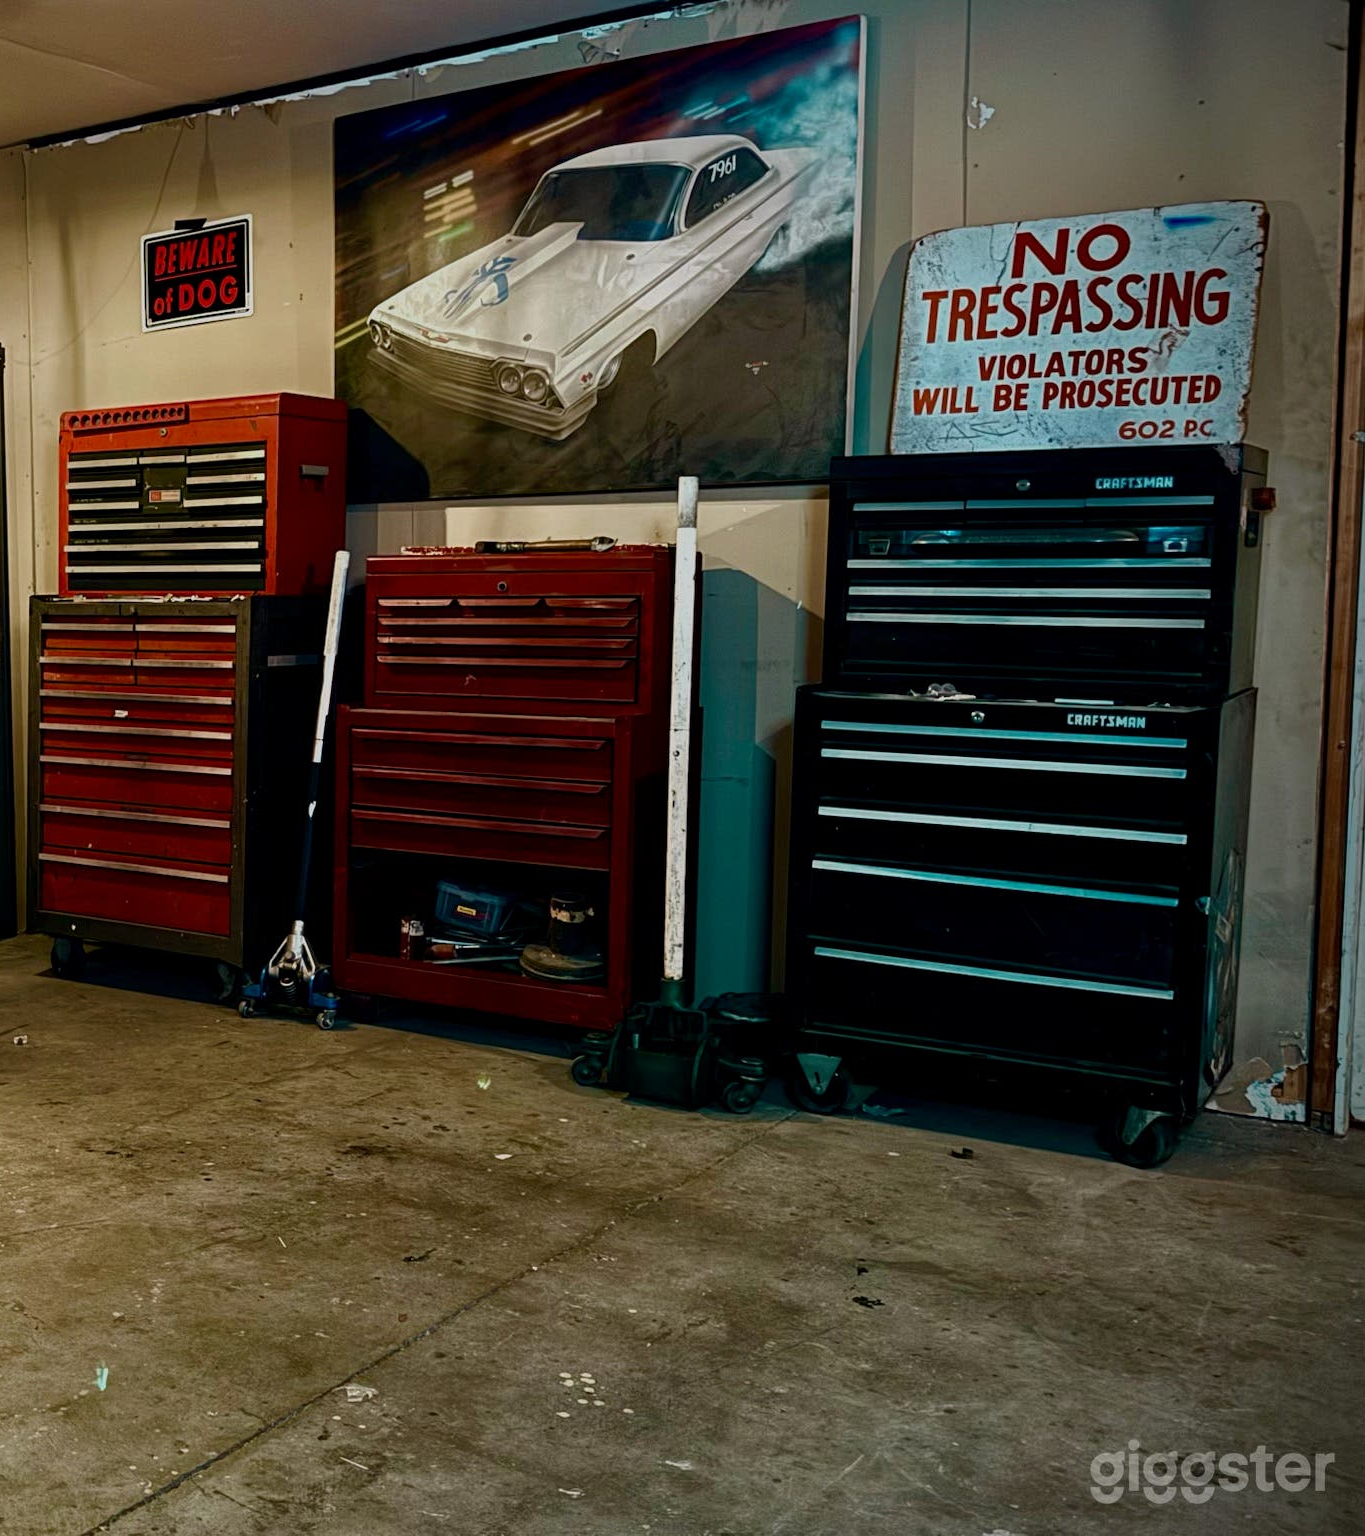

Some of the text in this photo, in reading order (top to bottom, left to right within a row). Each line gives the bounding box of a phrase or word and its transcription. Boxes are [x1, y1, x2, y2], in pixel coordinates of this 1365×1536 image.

[708, 154, 736, 183] 7961
[155, 231, 237, 276] BEWARE
[1011, 224, 1131, 279] NO
[154, 275, 238, 316] of DOG
[922, 268, 1231, 344] TRESPASSING
[978, 347, 1148, 381] VIOLATORS
[913, 374, 1222, 416] WILL BE PROSECUTED
[1118, 420, 1175, 440] 602
[1095, 476, 1174, 489] CRAFTSMAN
[1066, 713, 1147, 729] CRAFTSMAN
